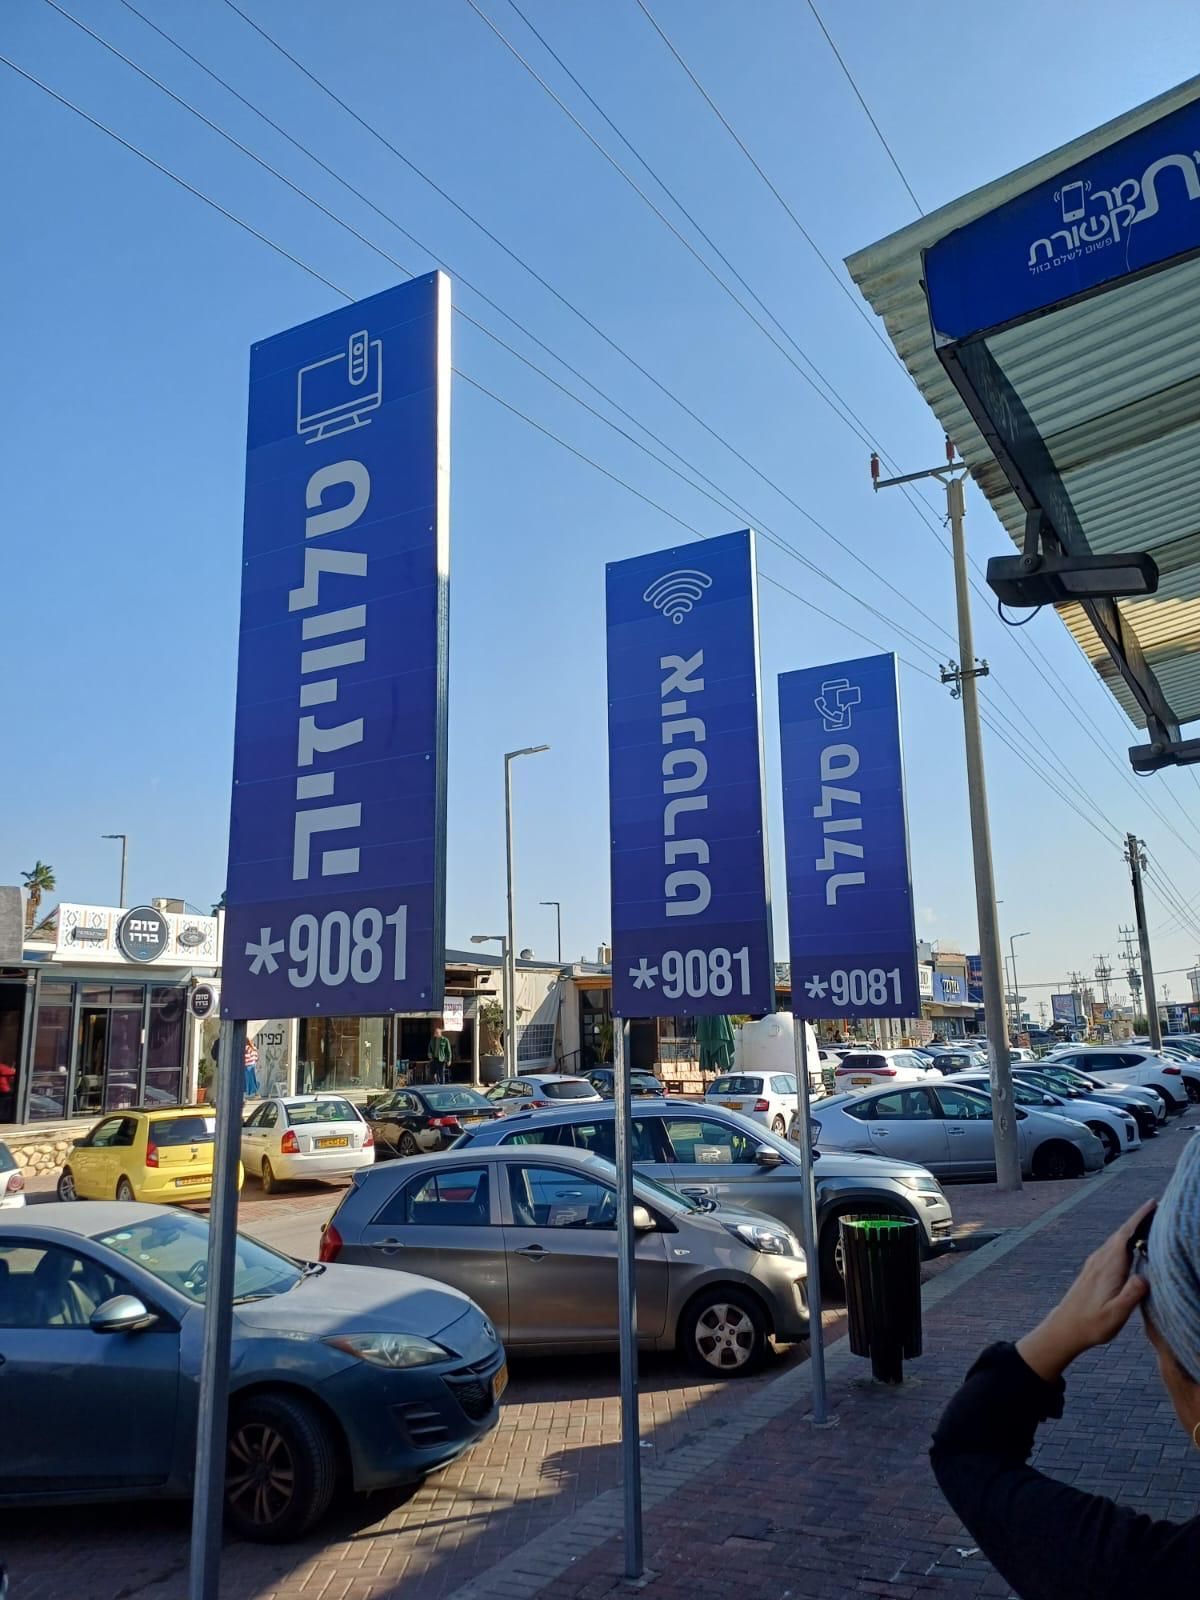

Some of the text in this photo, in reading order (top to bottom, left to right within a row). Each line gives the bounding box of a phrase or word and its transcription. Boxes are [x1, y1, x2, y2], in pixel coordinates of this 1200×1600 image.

[1029, 237, 1113, 276] פשוט לשלם בזול
[289, 459, 371, 881] טלוויזיה
[660, 649, 712, 917] אינטרנט
[813, 743, 866, 906] סלולר
[129, 919, 160, 932] סומ
[256, 1033, 283, 1049] פפיון
